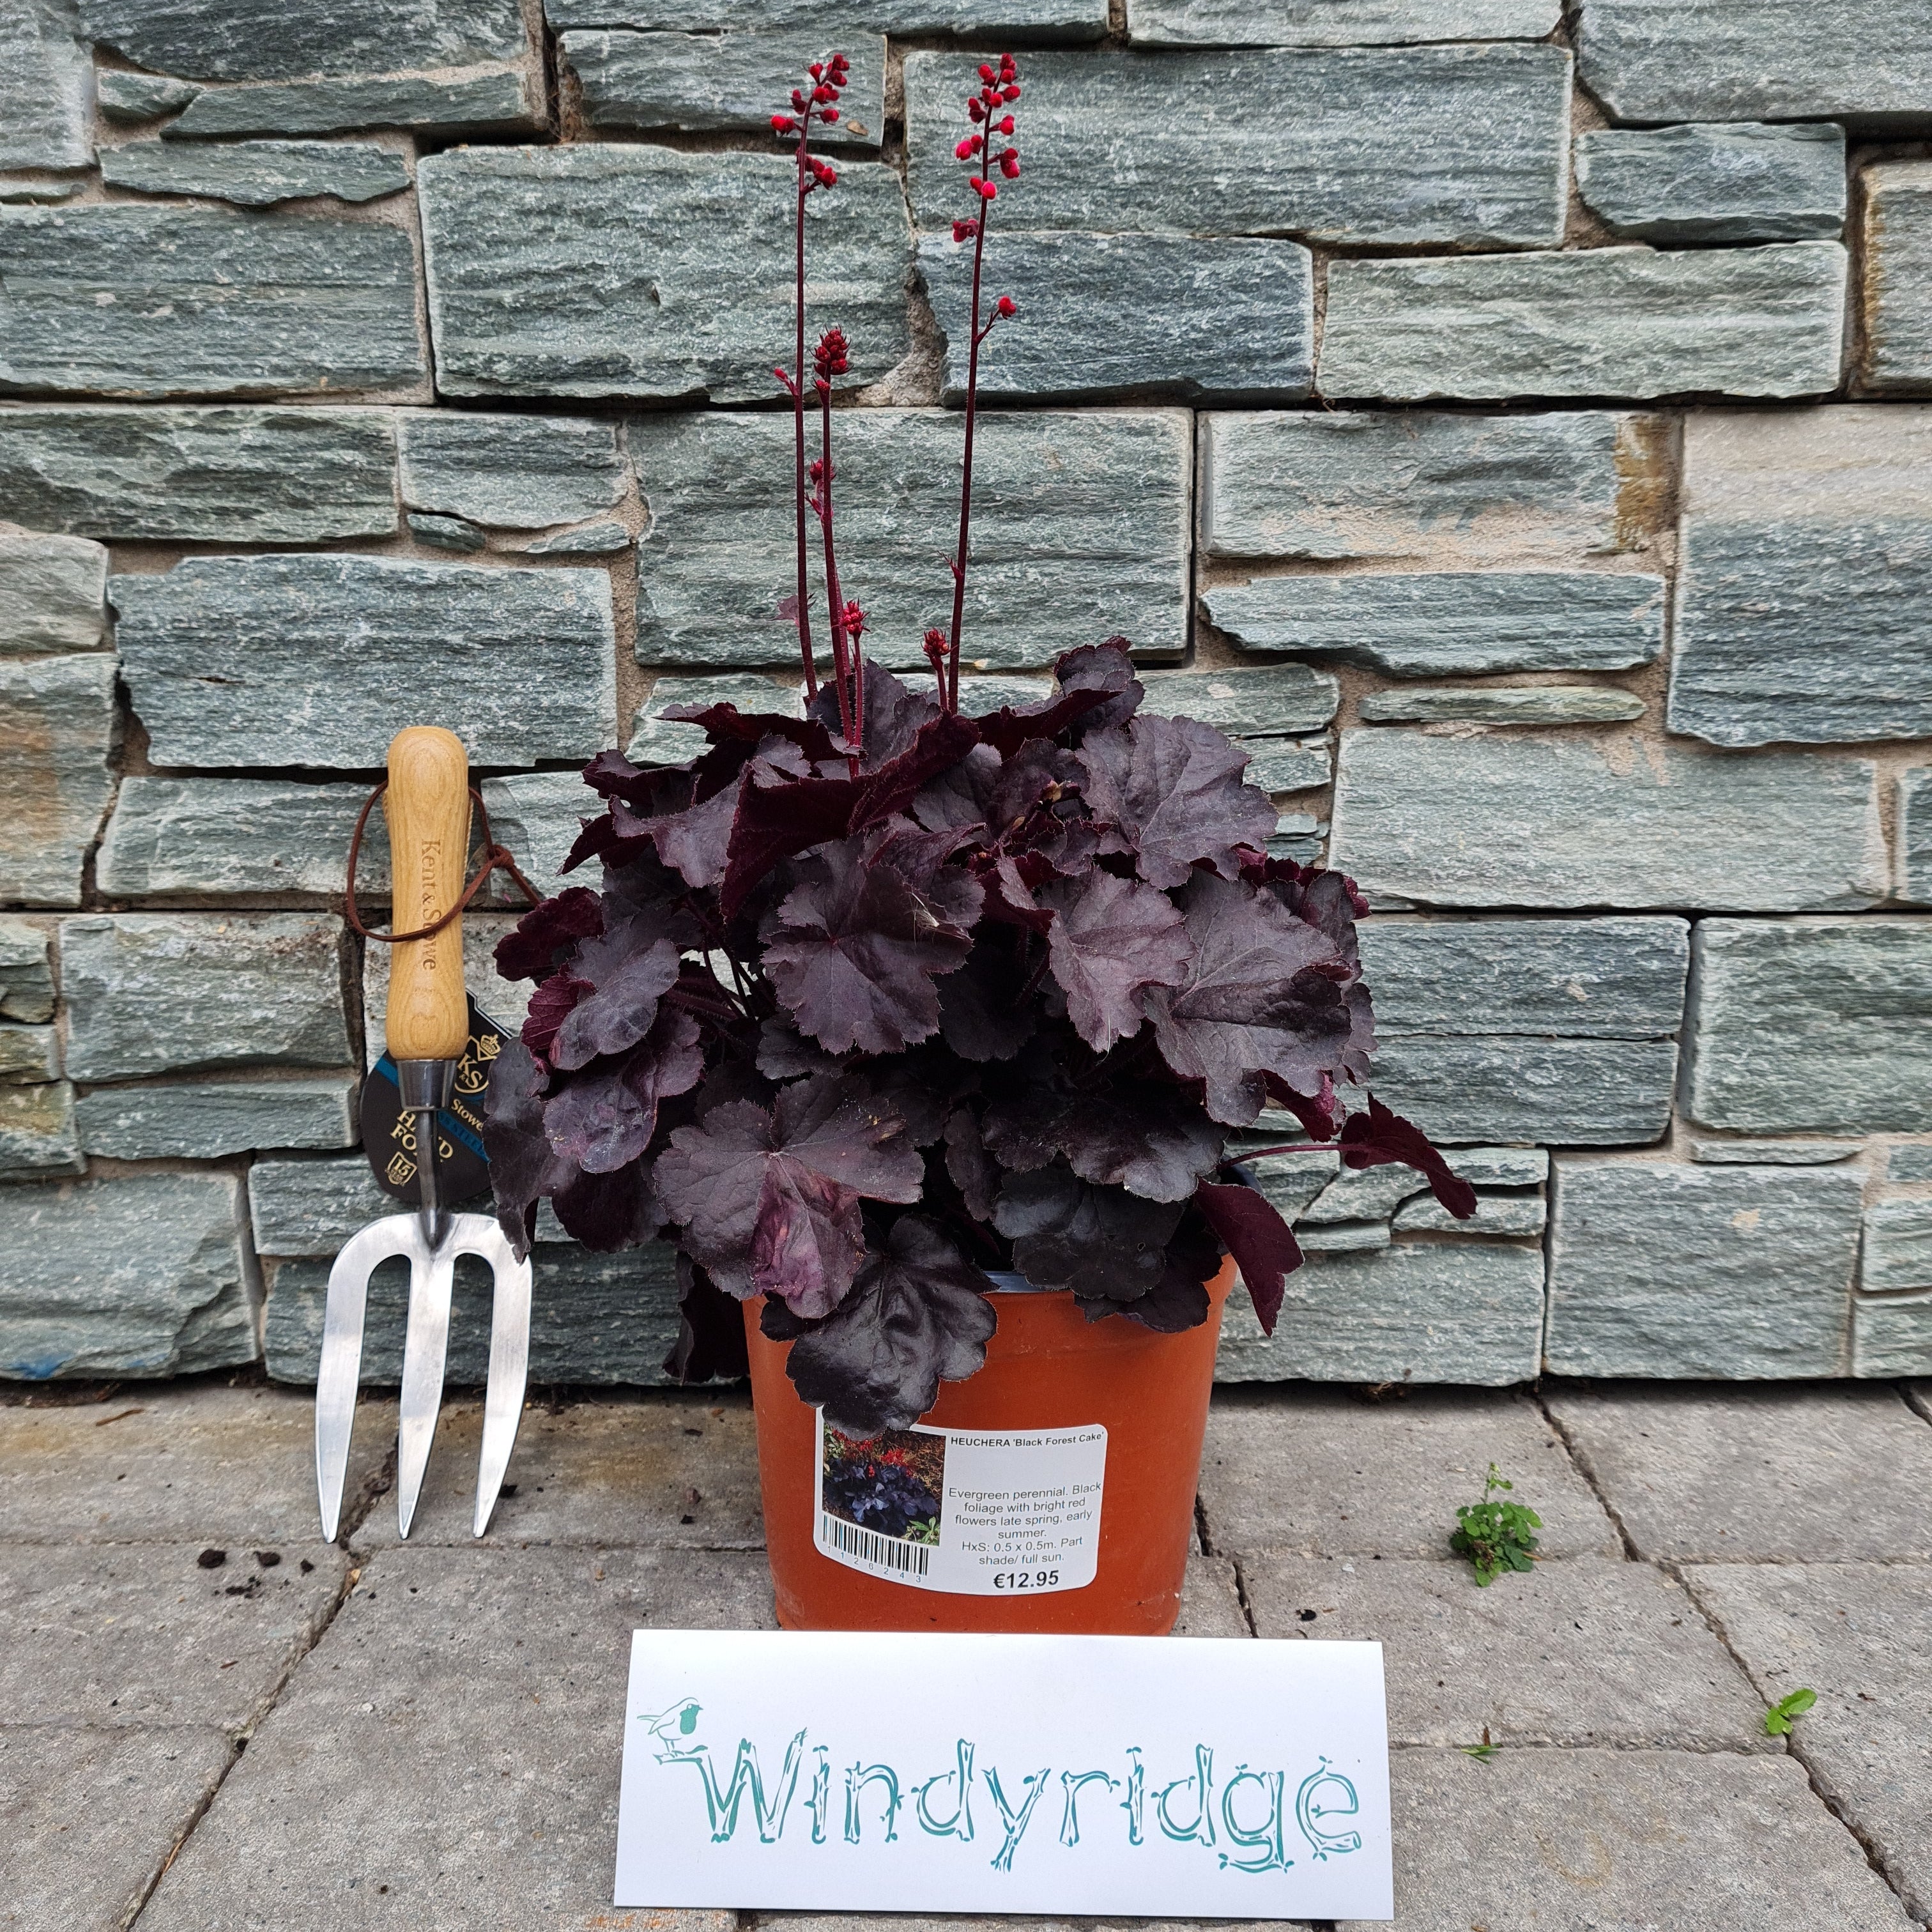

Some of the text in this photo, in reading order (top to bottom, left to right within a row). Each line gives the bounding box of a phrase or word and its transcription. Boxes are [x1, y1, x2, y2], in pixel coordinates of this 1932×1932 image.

[421, 839, 441, 889] Kent
[422, 892, 436, 905] &
[393, 1159, 411, 1176] 15
[951, 1436, 1011, 1447] HEUCHERA
[1013, 1438, 1043, 1446] 'Black
[1045, 1436, 1077, 1446] Forest
[949, 1482, 1101, 1501] Evergreen perennial. Black
[964, 1497, 1085, 1515] foliage with bright red
[955, 1509, 1092, 1527] flowers late spring, early
[998, 1529, 1047, 1539] summer.
[962, 1541, 990, 1552] HxS:
[993, 1542, 1012, 1552] 0.5
[1025, 1541, 1057, 1551] 0.5m.
[1061, 1537, 1083, 1547] Part
[979, 1553, 1064, 1565] shade/ full sun.
[993, 1569, 1059, 1589] €12.95
[654, 1728, 1361, 1873] Windyridge
